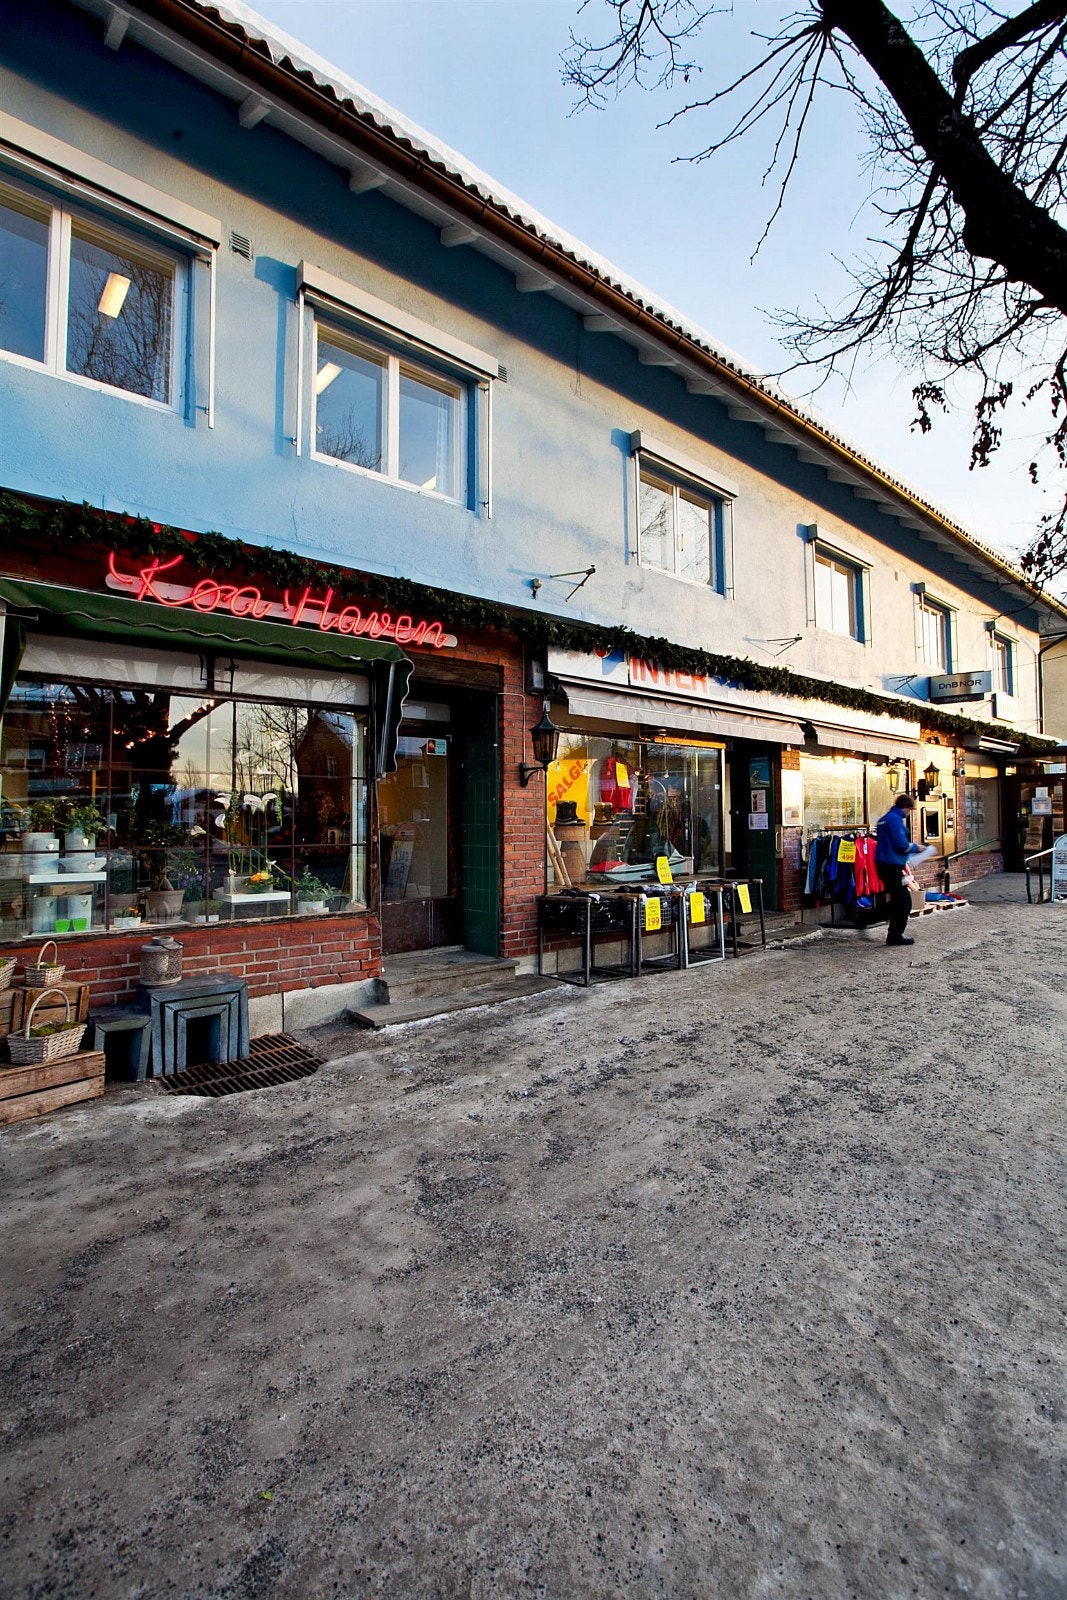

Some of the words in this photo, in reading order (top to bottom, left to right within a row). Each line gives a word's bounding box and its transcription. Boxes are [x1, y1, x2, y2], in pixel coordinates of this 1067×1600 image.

[938, 681, 959, 690] DnB
[959, 679, 982, 687] NOR
[547, 759, 583, 804] SALG!
[647, 916, 660, 926] 199
